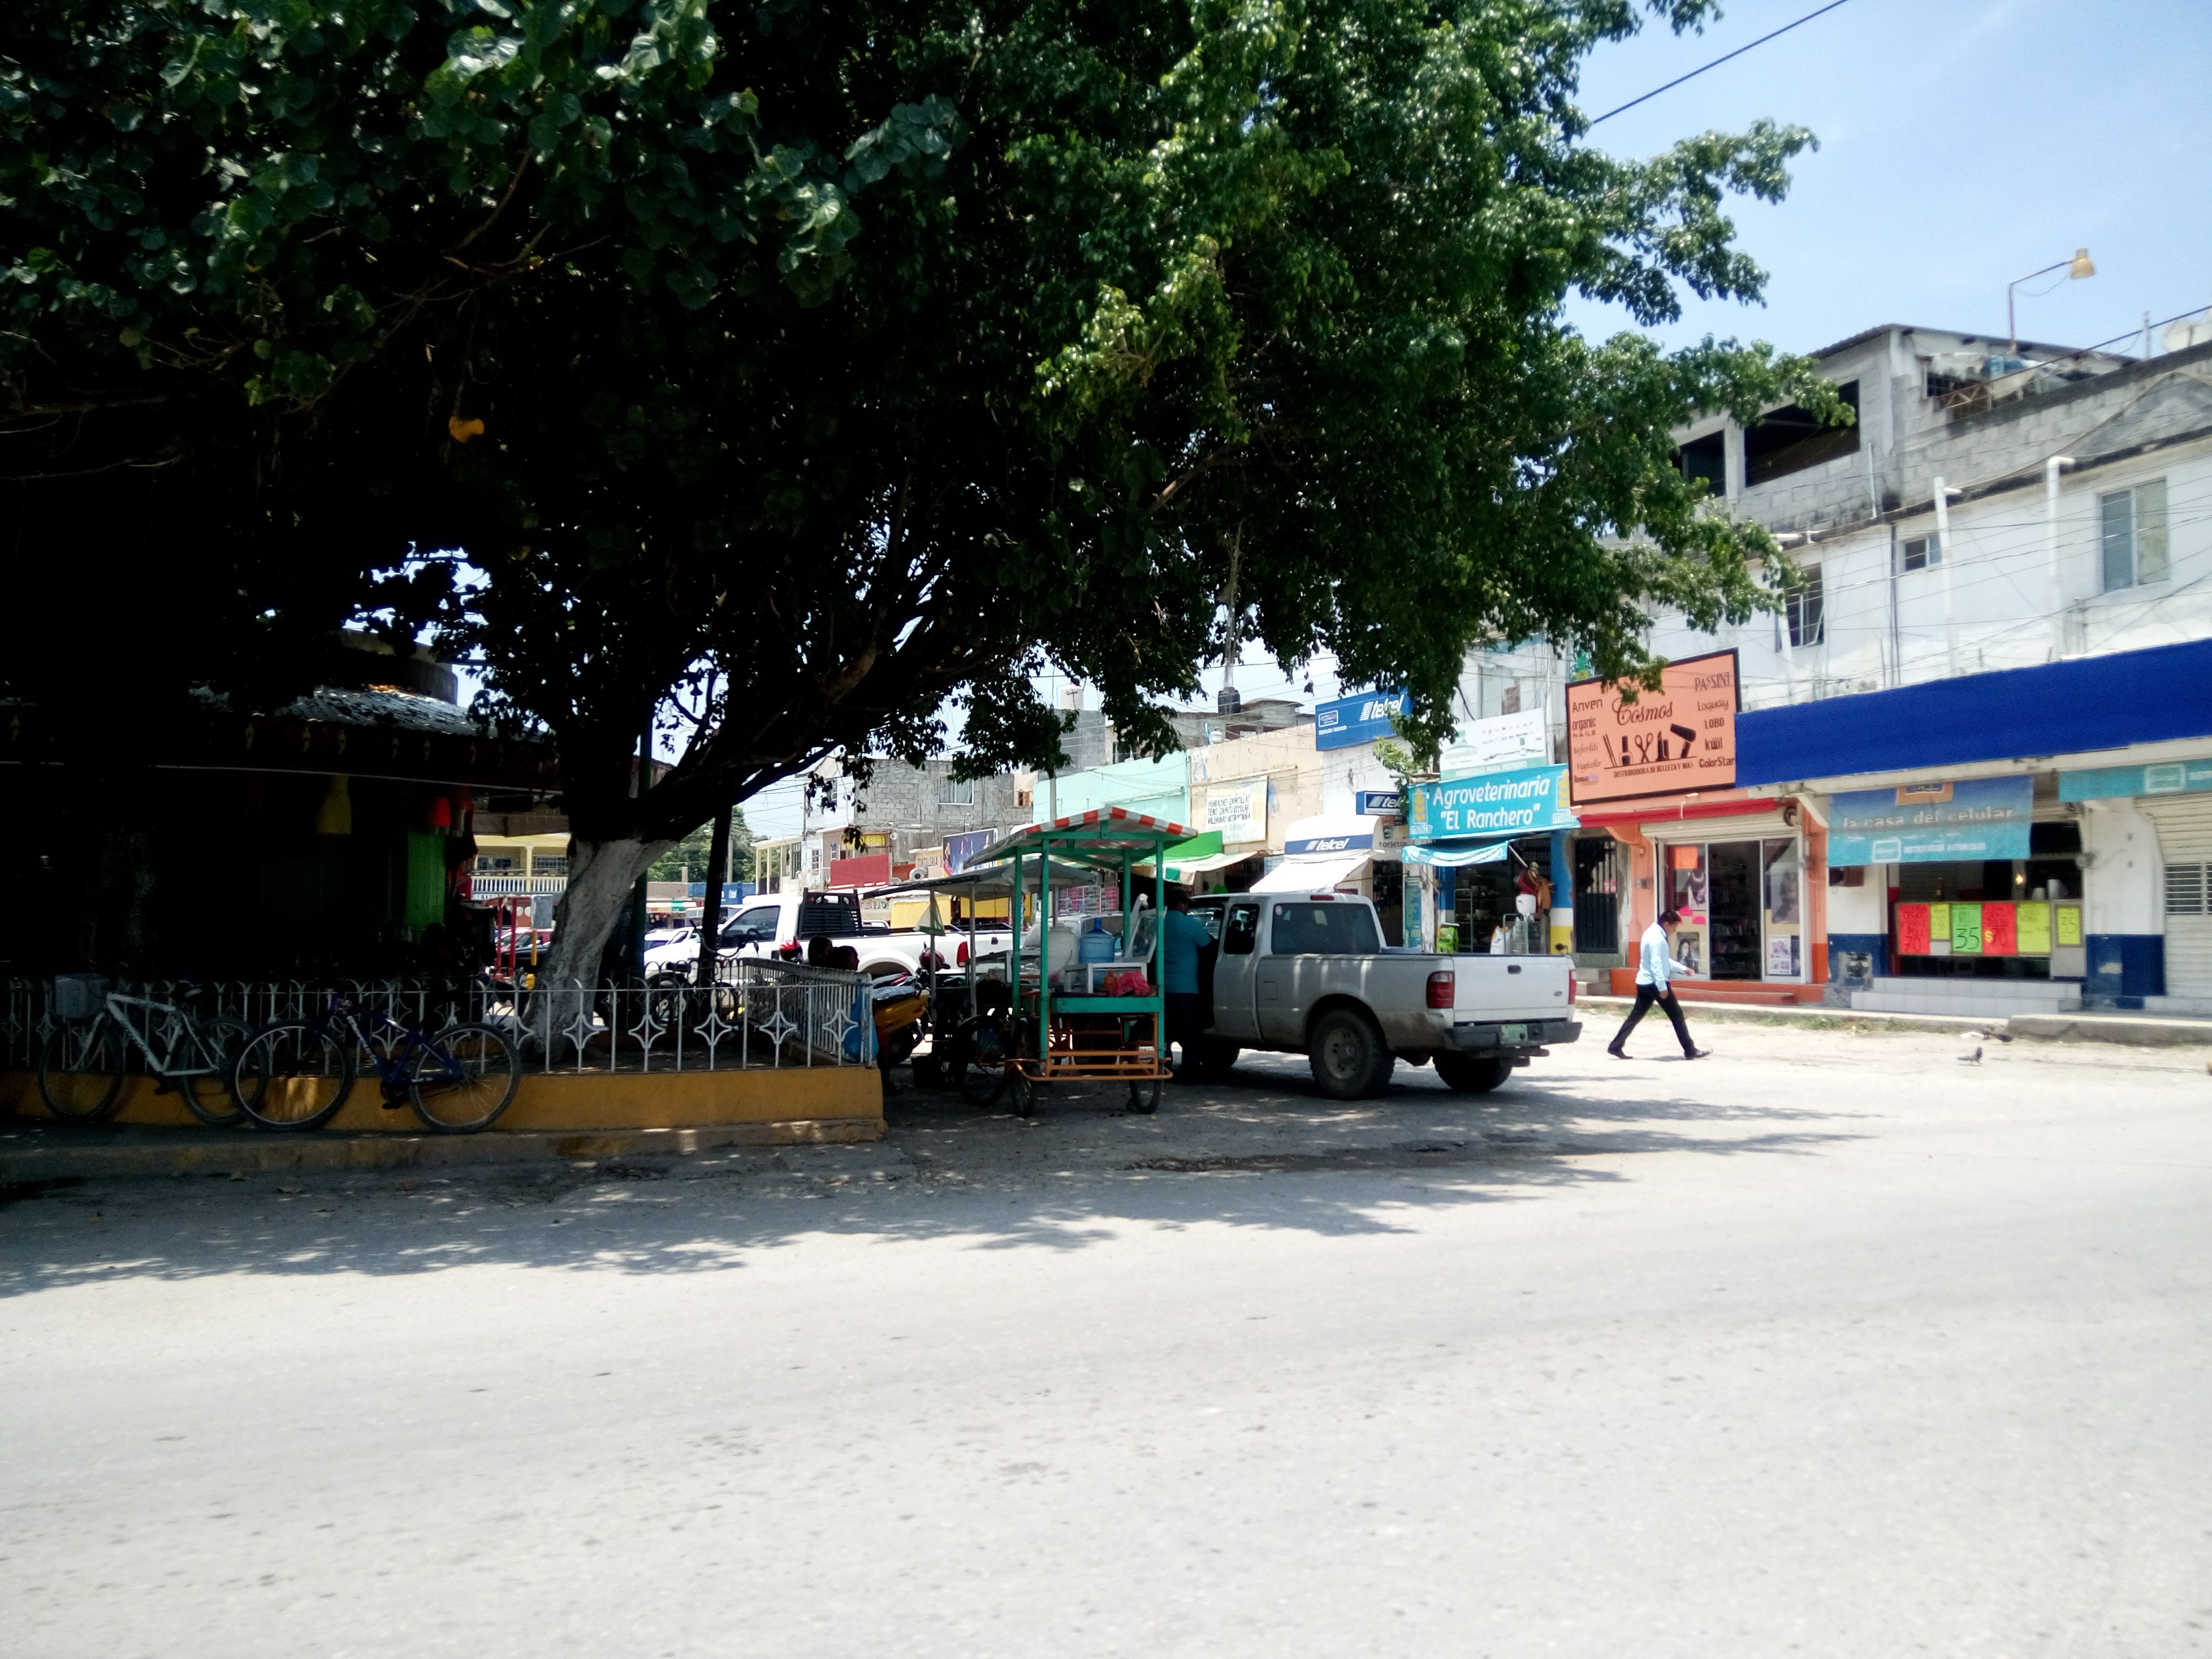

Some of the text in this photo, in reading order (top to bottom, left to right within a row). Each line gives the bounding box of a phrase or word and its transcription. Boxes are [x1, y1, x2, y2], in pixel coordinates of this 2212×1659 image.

[1612, 697, 1673, 725] Cosmos
[1572, 718, 1596, 731] organic
[1704, 717, 1724, 729] LOBO
[1433, 775, 1551, 810] Agroveterinaria
[1864, 815, 1904, 828] casa
[1913, 810, 1939, 825] del
[1948, 806, 2014, 822] celular
[1316, 838, 1350, 851] telcel
[1954, 927, 1980, 950] 35
